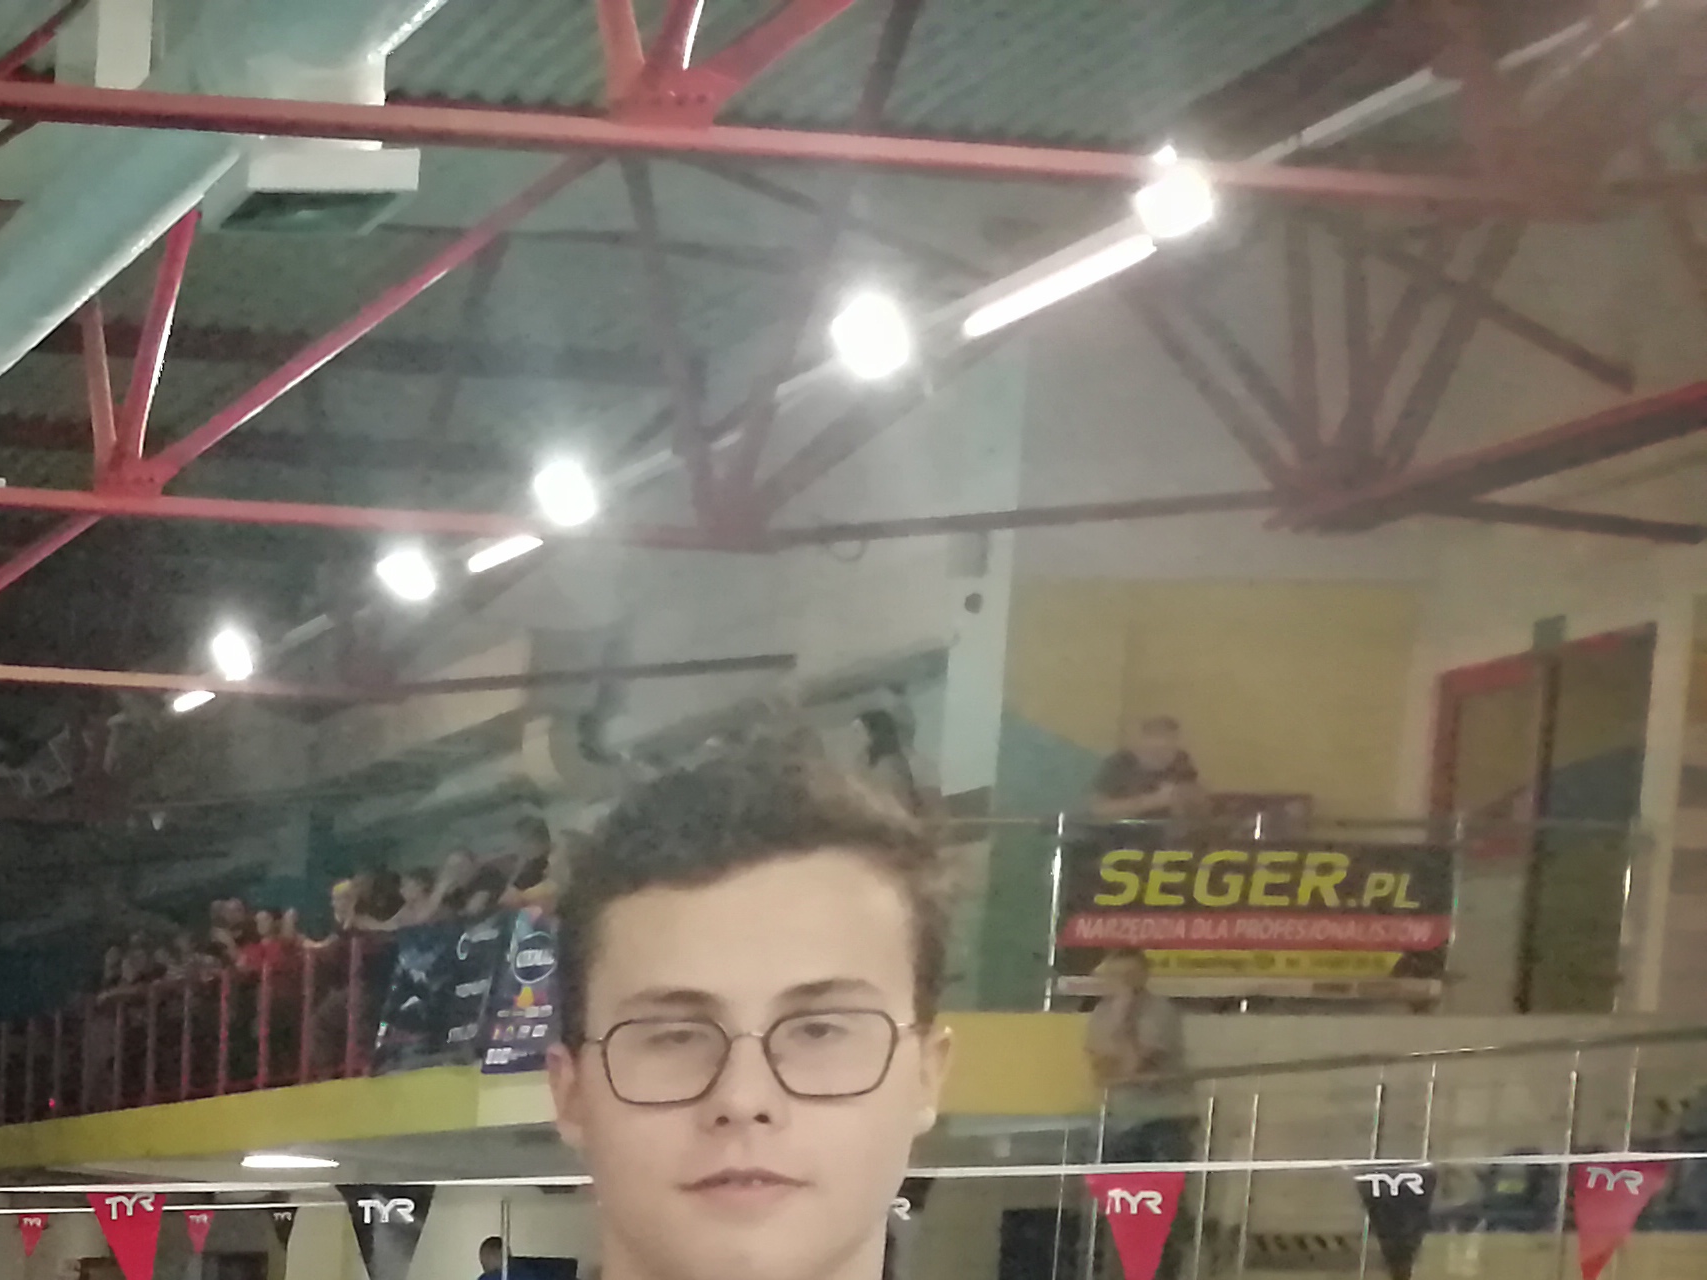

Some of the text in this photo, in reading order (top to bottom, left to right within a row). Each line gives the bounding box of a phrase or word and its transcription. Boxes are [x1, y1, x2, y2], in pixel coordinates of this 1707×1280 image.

[1094, 849, 1421, 909] SEGER.PL
[1357, 1173, 1424, 1197] TYR
[1586, 1167, 1645, 1195] TYR
[105, 1193, 155, 1220] TYR
[357, 1198, 416, 1224] TYR
[1107, 1189, 1163, 1215] TYR
